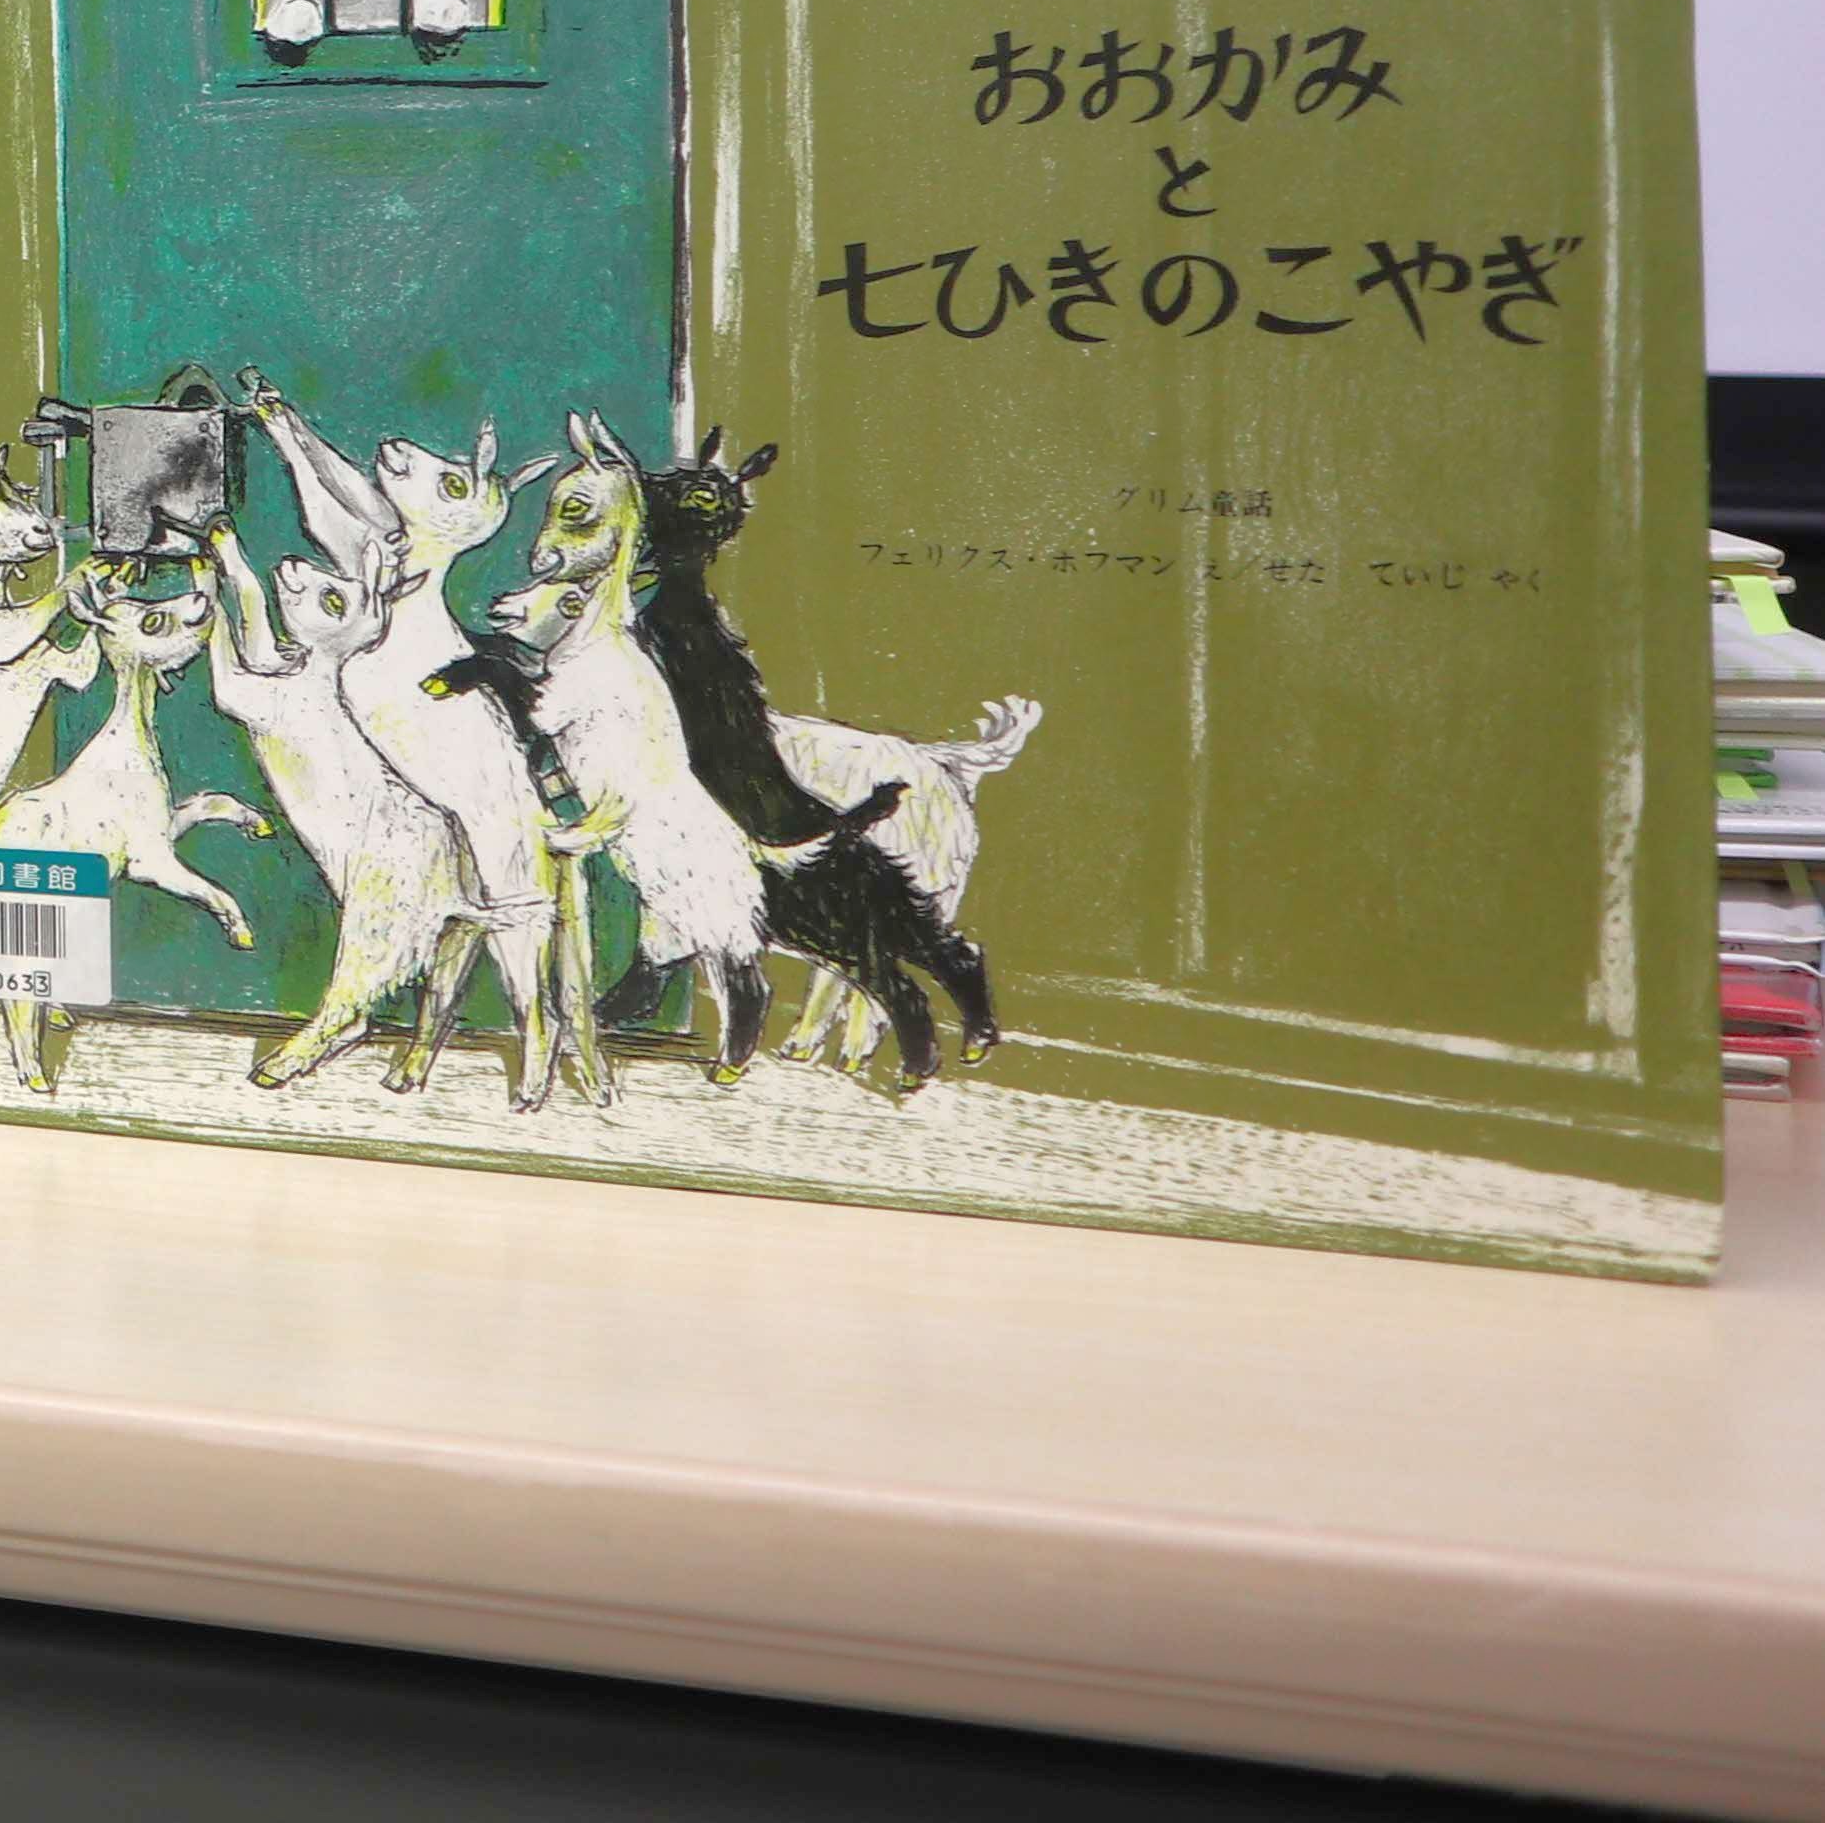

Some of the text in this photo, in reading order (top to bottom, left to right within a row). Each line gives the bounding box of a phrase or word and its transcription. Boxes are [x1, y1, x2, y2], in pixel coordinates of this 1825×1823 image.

[969, 25, 1404, 126] おおかみ
[1153, 145, 1218, 218] と
[815, 233, 1581, 346] 七ひきのこやぎ
[1111, 484, 1274, 520] グリム童話
[859, 542, 1182, 578] フェリクス・ホフマン
